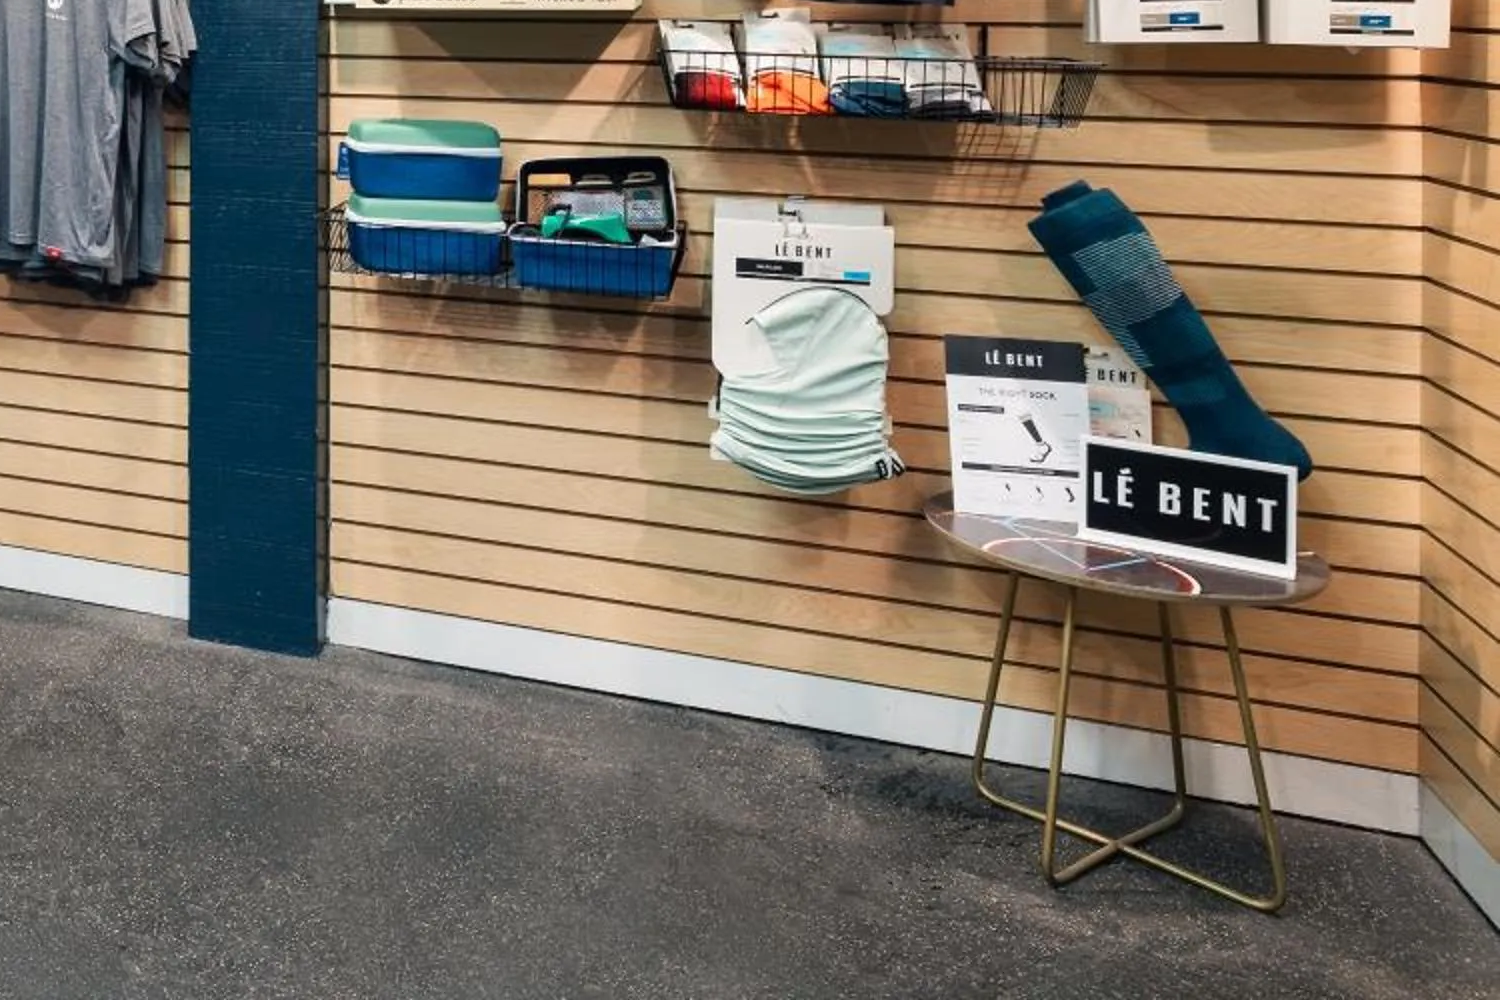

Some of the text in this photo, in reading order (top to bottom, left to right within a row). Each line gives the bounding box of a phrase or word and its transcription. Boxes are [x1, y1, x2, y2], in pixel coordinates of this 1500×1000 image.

[795, 244, 832, 259] BENT
[1005, 353, 1044, 368] BENT
[1097, 368, 1137, 384] BENT
[1093, 467, 1279, 533] LÉ BENT
